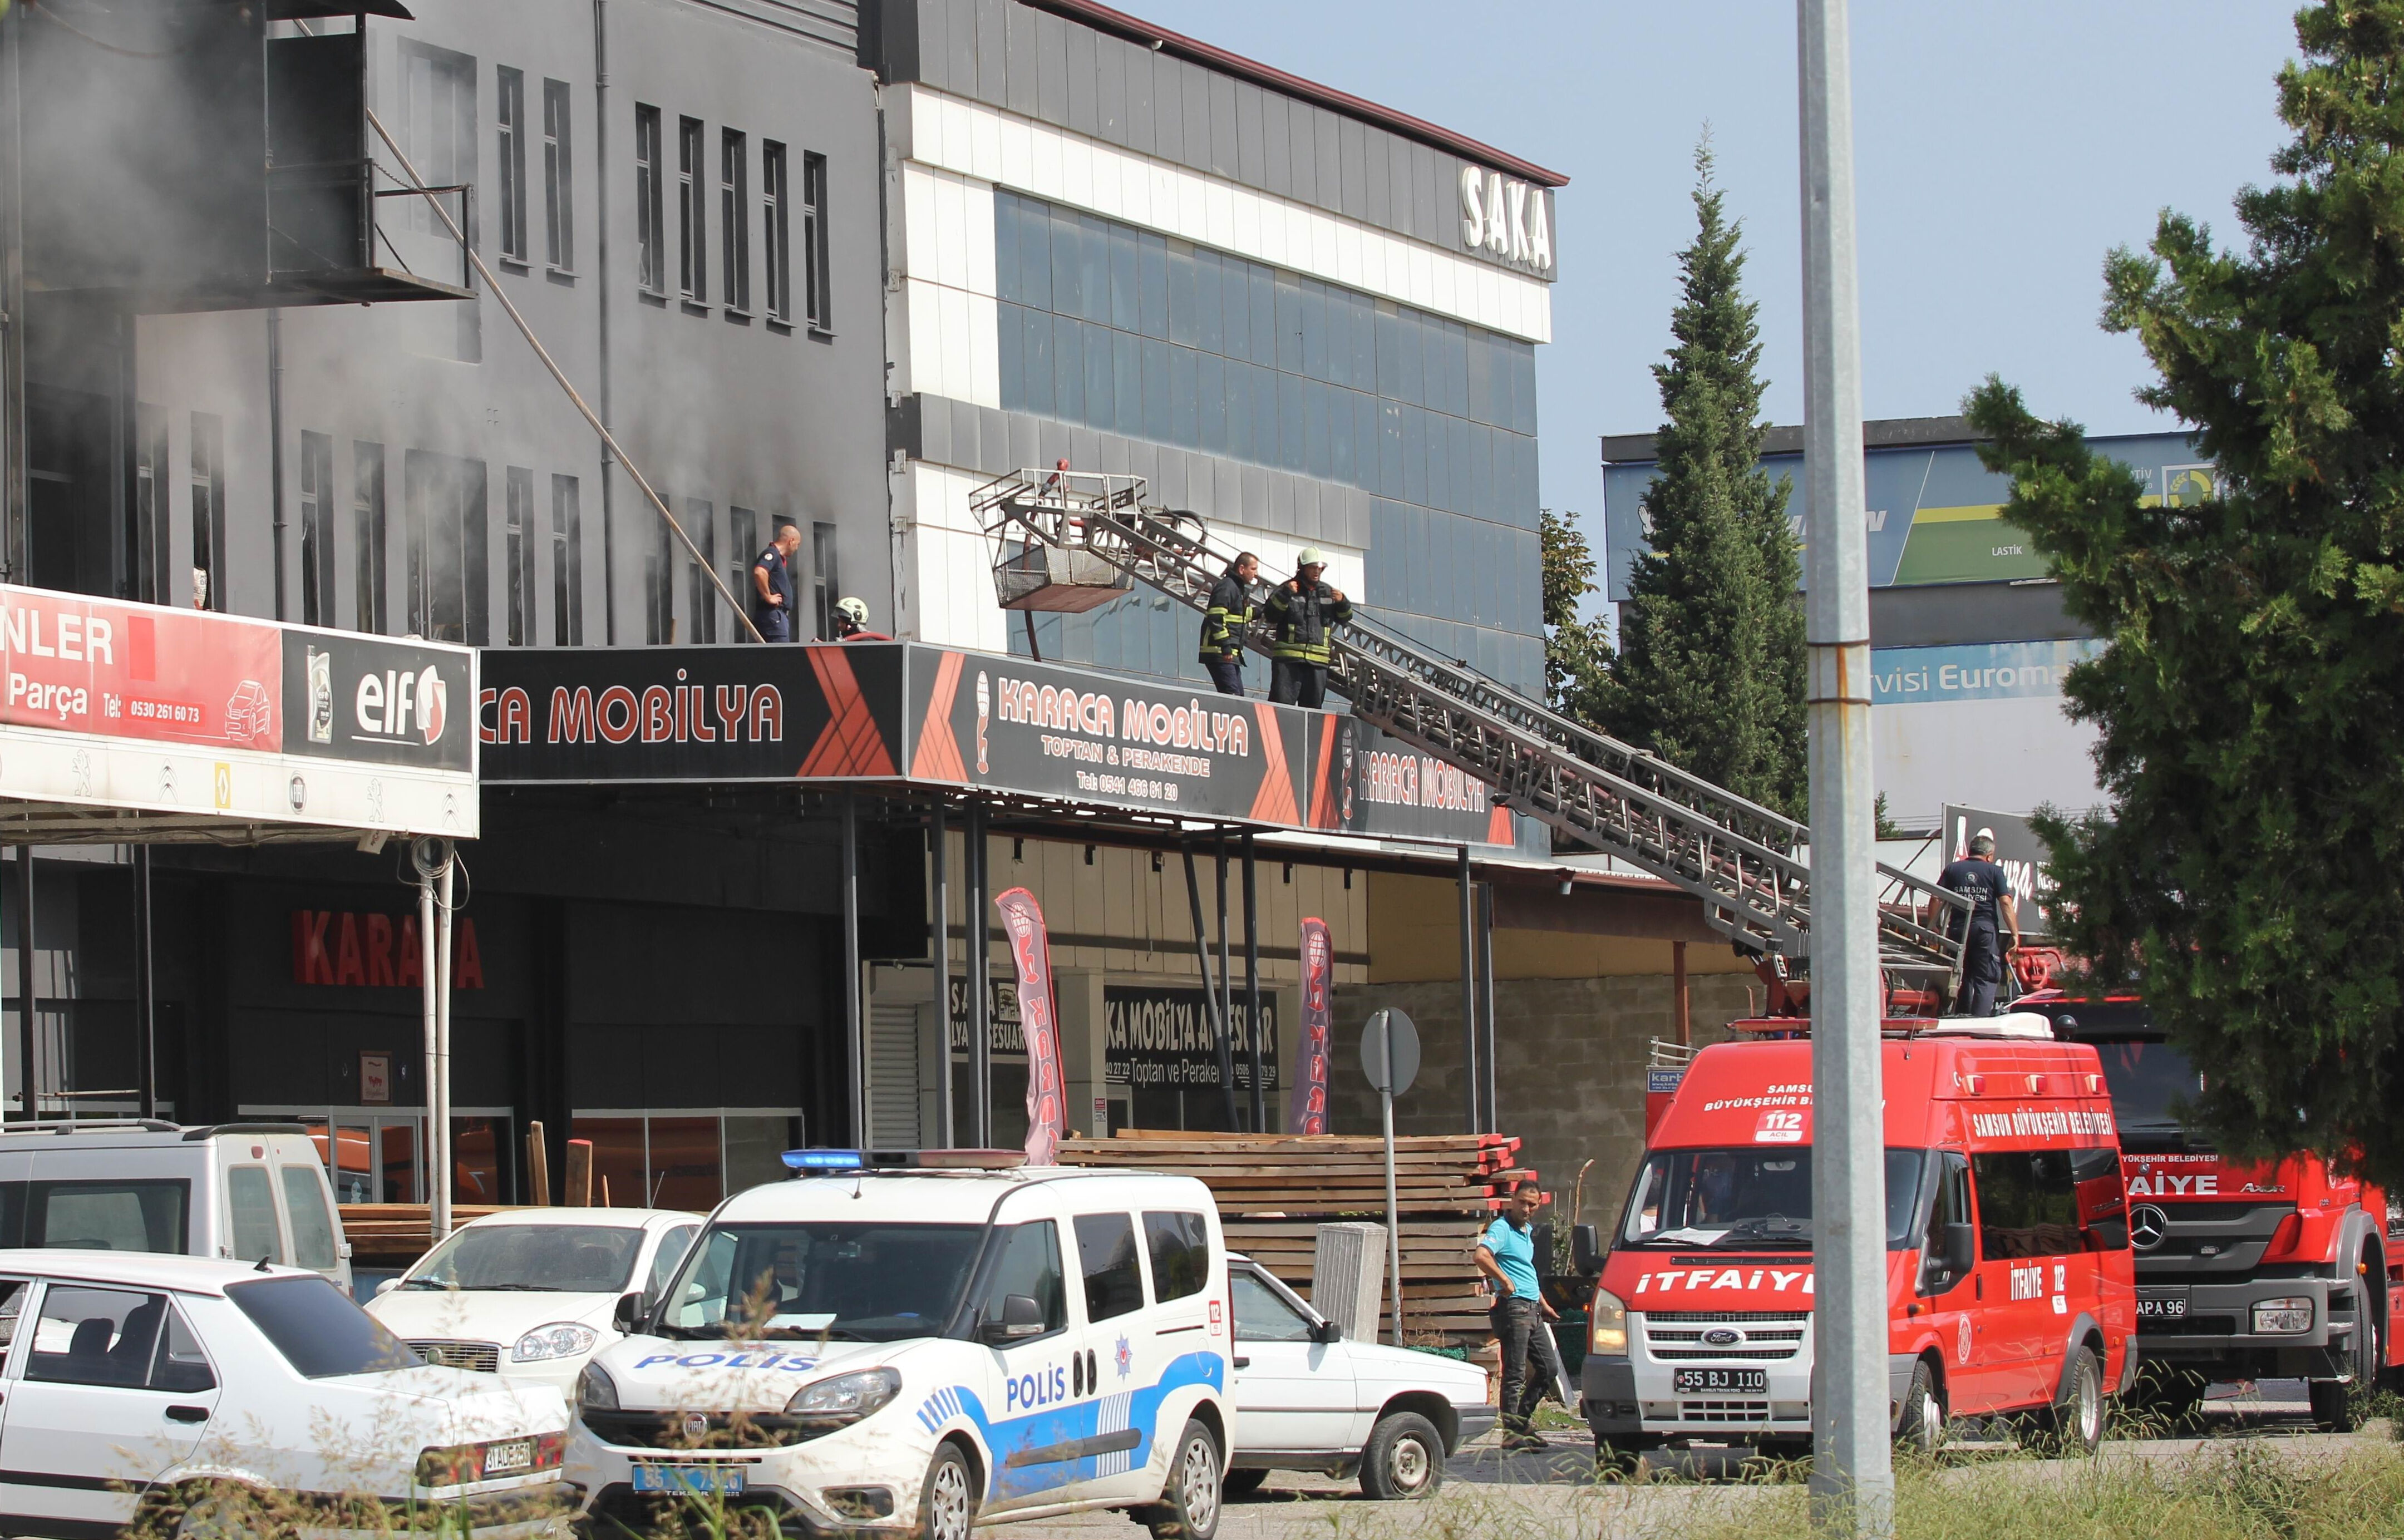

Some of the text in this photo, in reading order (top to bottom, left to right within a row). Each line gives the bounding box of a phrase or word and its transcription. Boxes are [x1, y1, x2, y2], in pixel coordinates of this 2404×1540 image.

[1462, 166, 1551, 270] SAKA
[1992, 544, 2023, 556] LASTİK
[0, 605, 114, 665] NLER
[1870, 665, 1928, 693] visi
[9, 672, 87, 720] Parça
[104, 693, 199, 723] Tel: 0530 261 60 73
[357, 670, 415, 735] elf
[548, 668, 783, 744] MOBİLYA
[999, 677, 1249, 757] KARACA MOBİLYA
[1041, 734, 1210, 778] TOPTAN & PERAKENDE
[1077, 771, 1178, 802] Tel: 0541 466 81 20
[1359, 751, 1418, 806] KARACA
[1954, 886, 1988, 894] SAMSUN
[292, 909, 485, 989] KARAA
[1105, 1000, 1127, 1050] KA
[1130, 998, 1195, 1052] MOBİLYA
[1114, 1062, 1121, 1075] 27
[1122, 1063, 1130, 1075] 22
[1131, 1058, 1164, 1089] Toptan
[1167, 1065, 1179, 1082] ve
[1236, 1063, 1249, 1075] 0506
[1703, 1094, 1796, 1112] BÜYÜKŞEHİR
[1766, 1113, 1802, 1129] 112
[1973, 1107, 2113, 1141] SAMSUN BÜYÜKŞEHİR BELEDİYESİ
[2168, 1154, 2218, 1162] BELEDİYESİ
[2011, 1260, 2065, 1301] İTFAİYE 112
[1210, 1304, 1220, 1321] 112
[2166, 1301, 2184, 1314] 96
[1711, 1332, 1732, 1342] Ford
[633, 1353, 820, 1371] POLİS
[1007, 1361, 1065, 1412] POLİS
[1684, 1371, 1763, 1387] 55 BJ 110
[688, 1420, 702, 1432] FIAT
